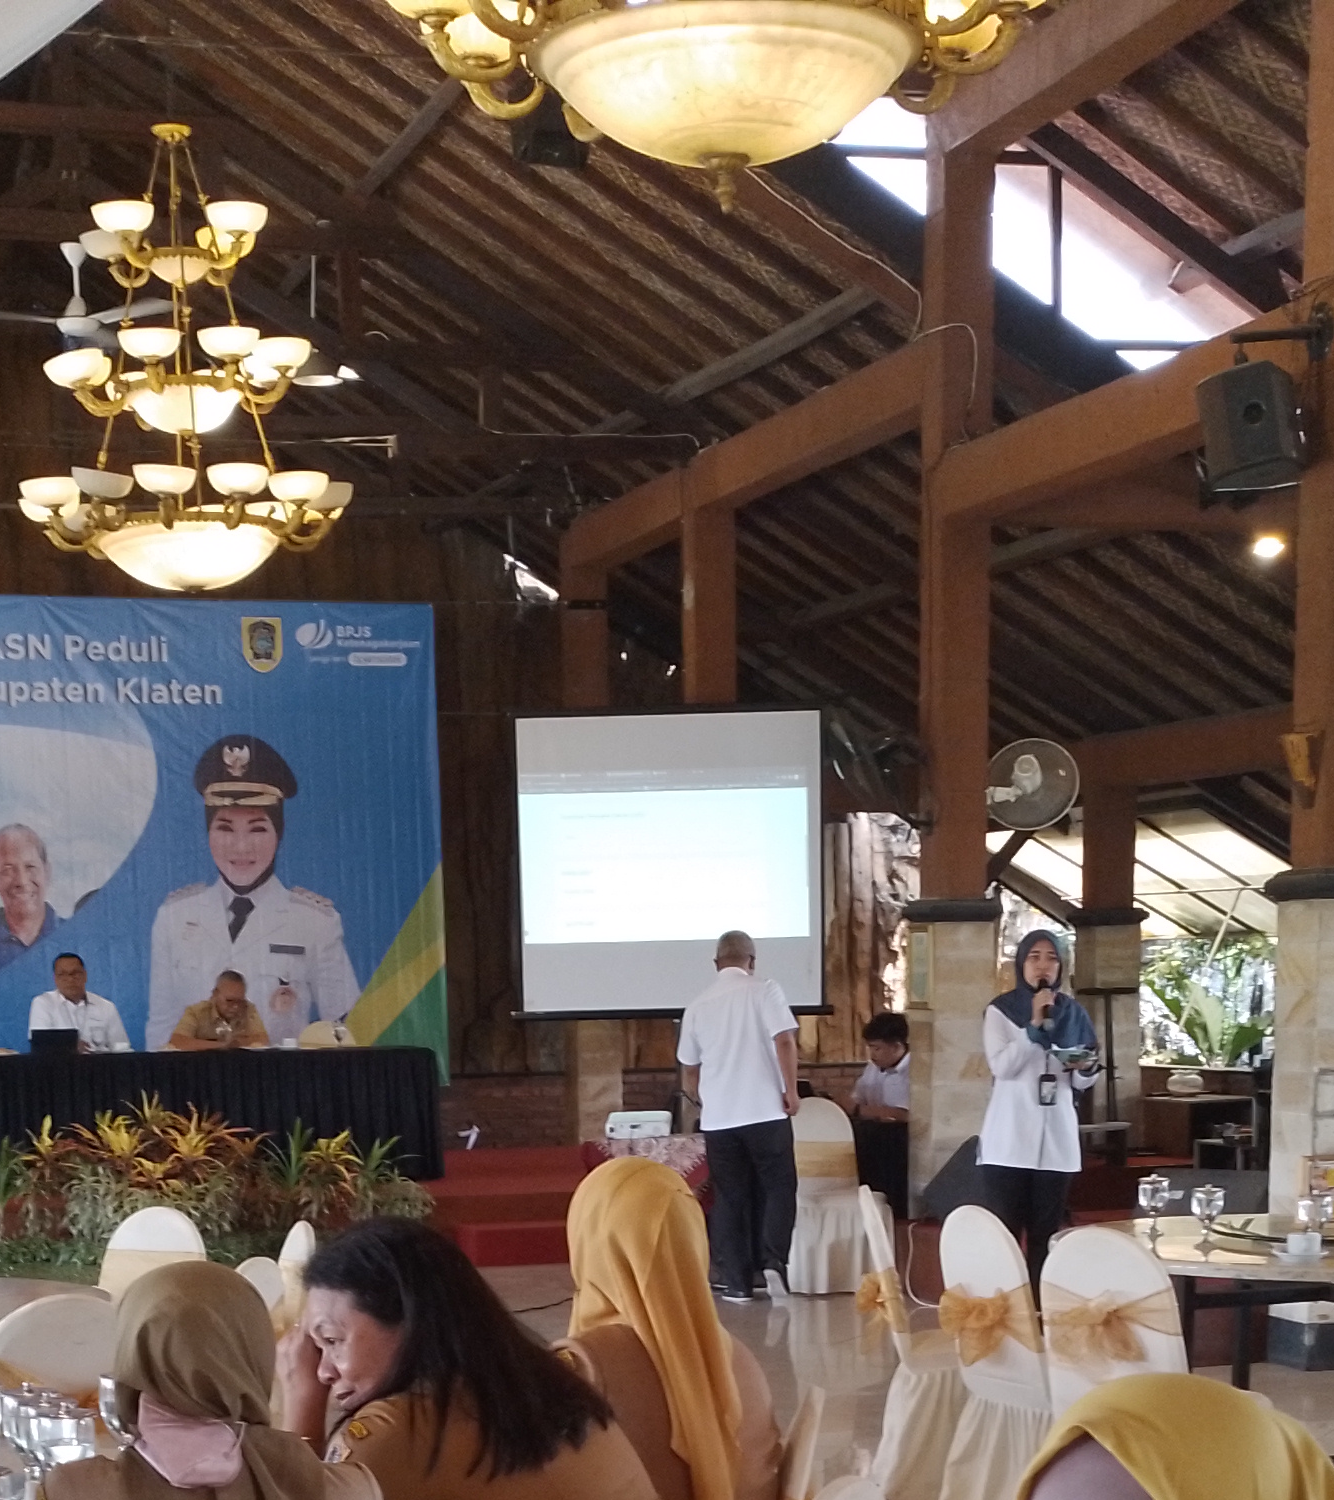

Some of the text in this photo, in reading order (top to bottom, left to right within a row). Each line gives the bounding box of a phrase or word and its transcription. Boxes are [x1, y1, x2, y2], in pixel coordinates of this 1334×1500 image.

[336, 625, 373, 639] BPJS
[64, 634, 169, 662] Peduli
[117, 676, 224, 705] Klaten
